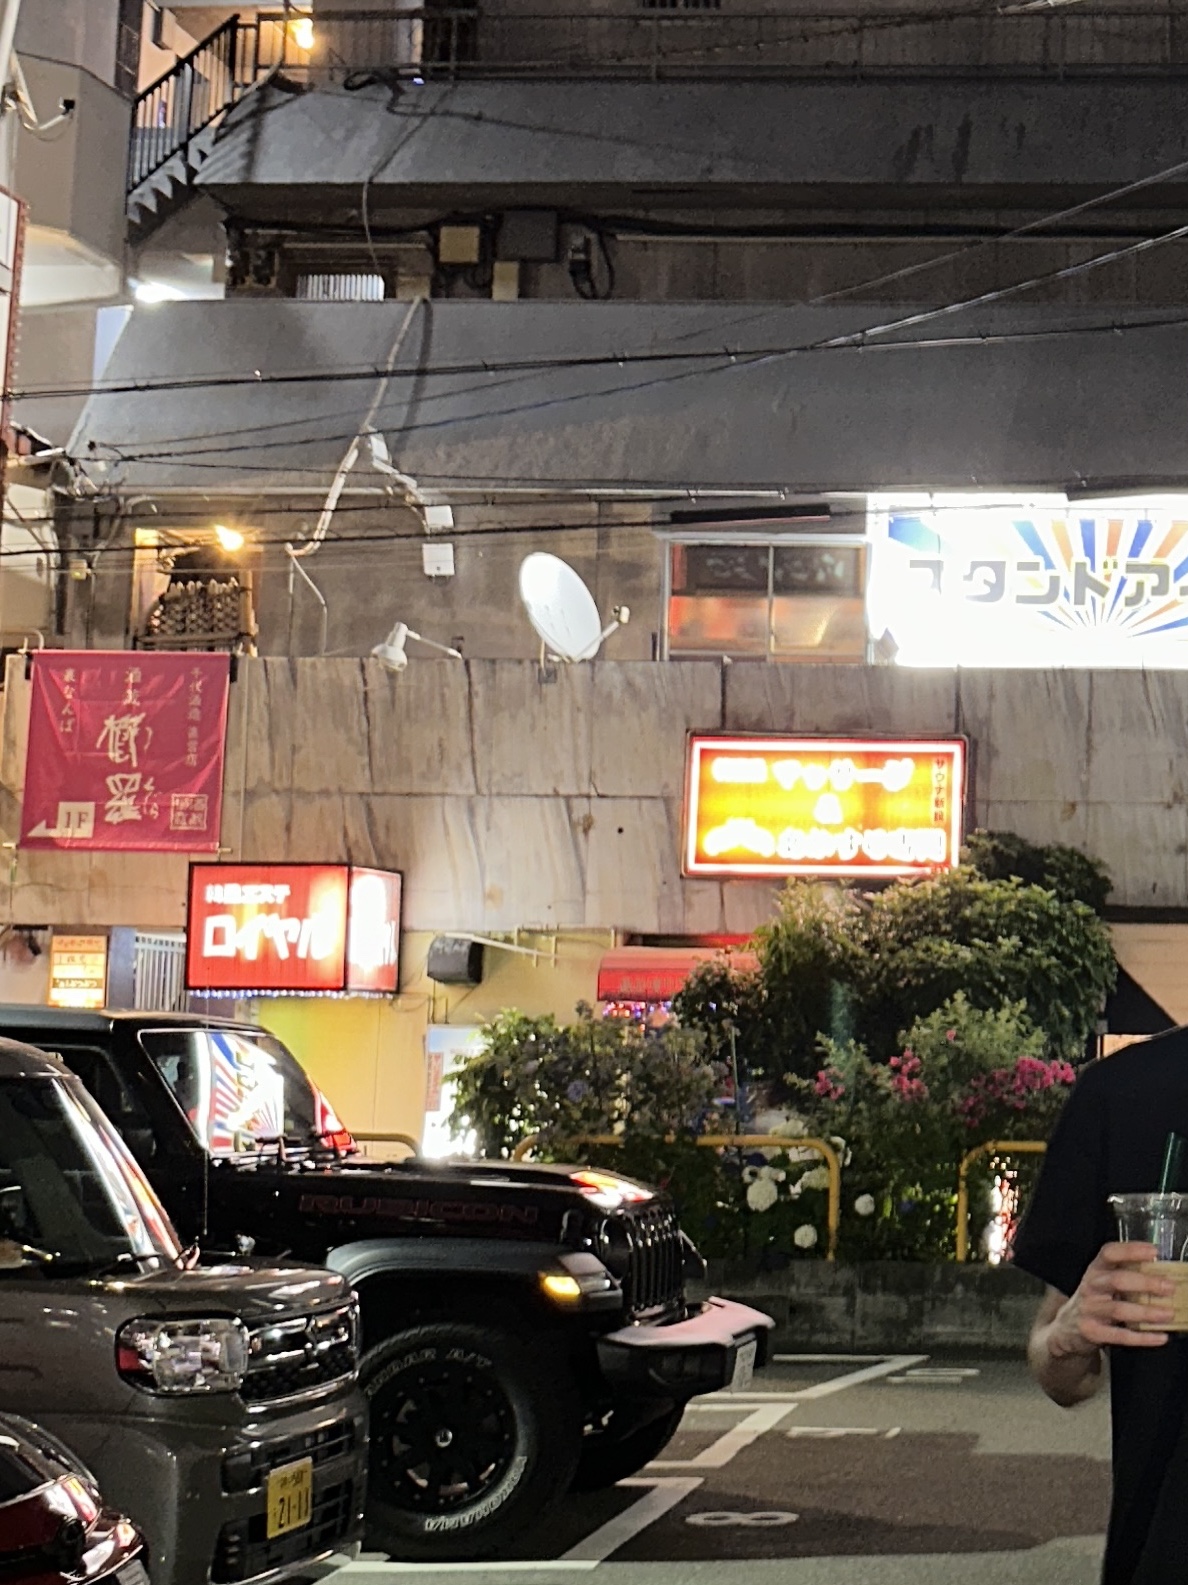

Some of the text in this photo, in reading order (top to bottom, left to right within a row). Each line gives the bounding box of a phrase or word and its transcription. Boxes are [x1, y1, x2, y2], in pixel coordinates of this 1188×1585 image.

[65, 811, 89, 829] 1F
[299, 1194, 539, 1224] RUBICON
[685, 1511, 799, 1527] 8
